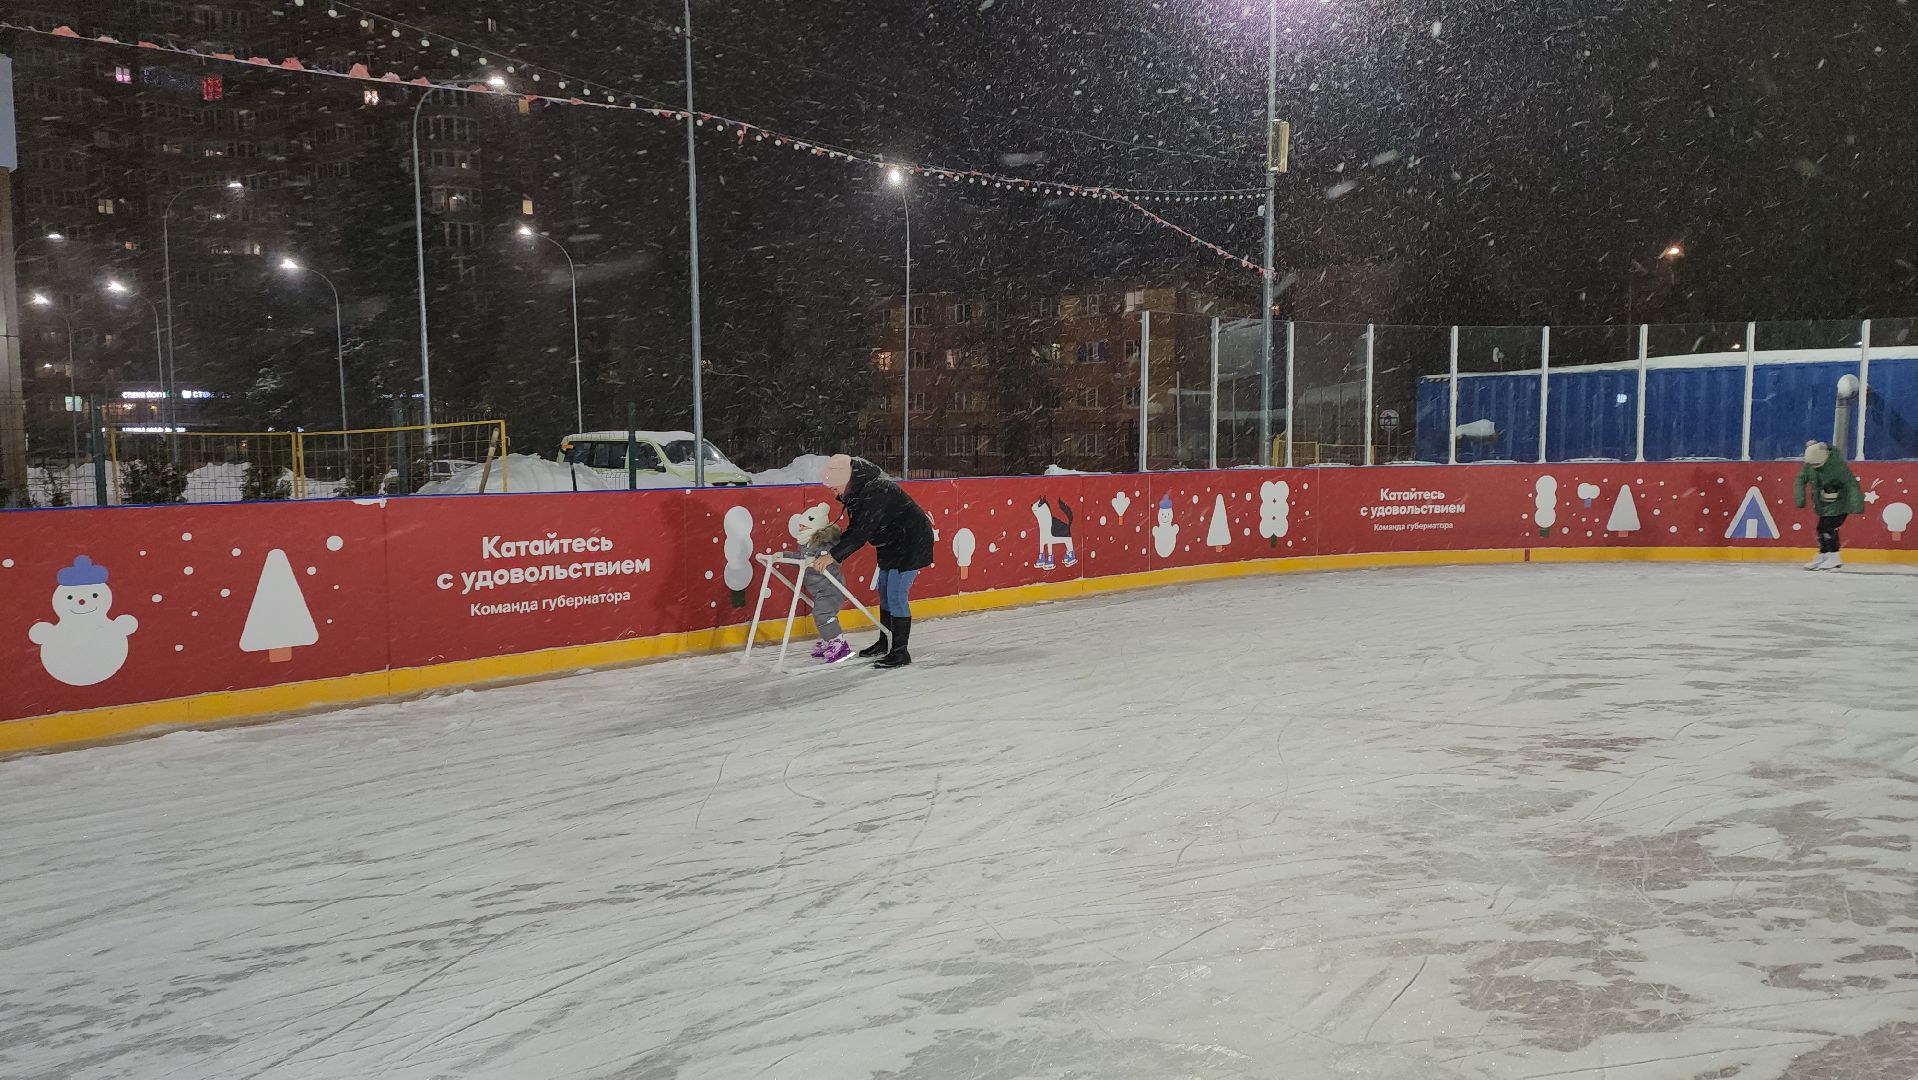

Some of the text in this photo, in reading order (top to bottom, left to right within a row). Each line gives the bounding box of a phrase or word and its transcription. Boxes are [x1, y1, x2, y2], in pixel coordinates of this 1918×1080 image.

[1380, 487, 1446, 501] Катайтесь
[1360, 503, 1465, 518] с удовольствием
[1374, 522, 1453, 531] Команда губернатора
[482, 532, 614, 559] Катайтесь
[436, 557, 651, 595] с удовольствием
[470, 591, 631, 617] Команда губернатора
